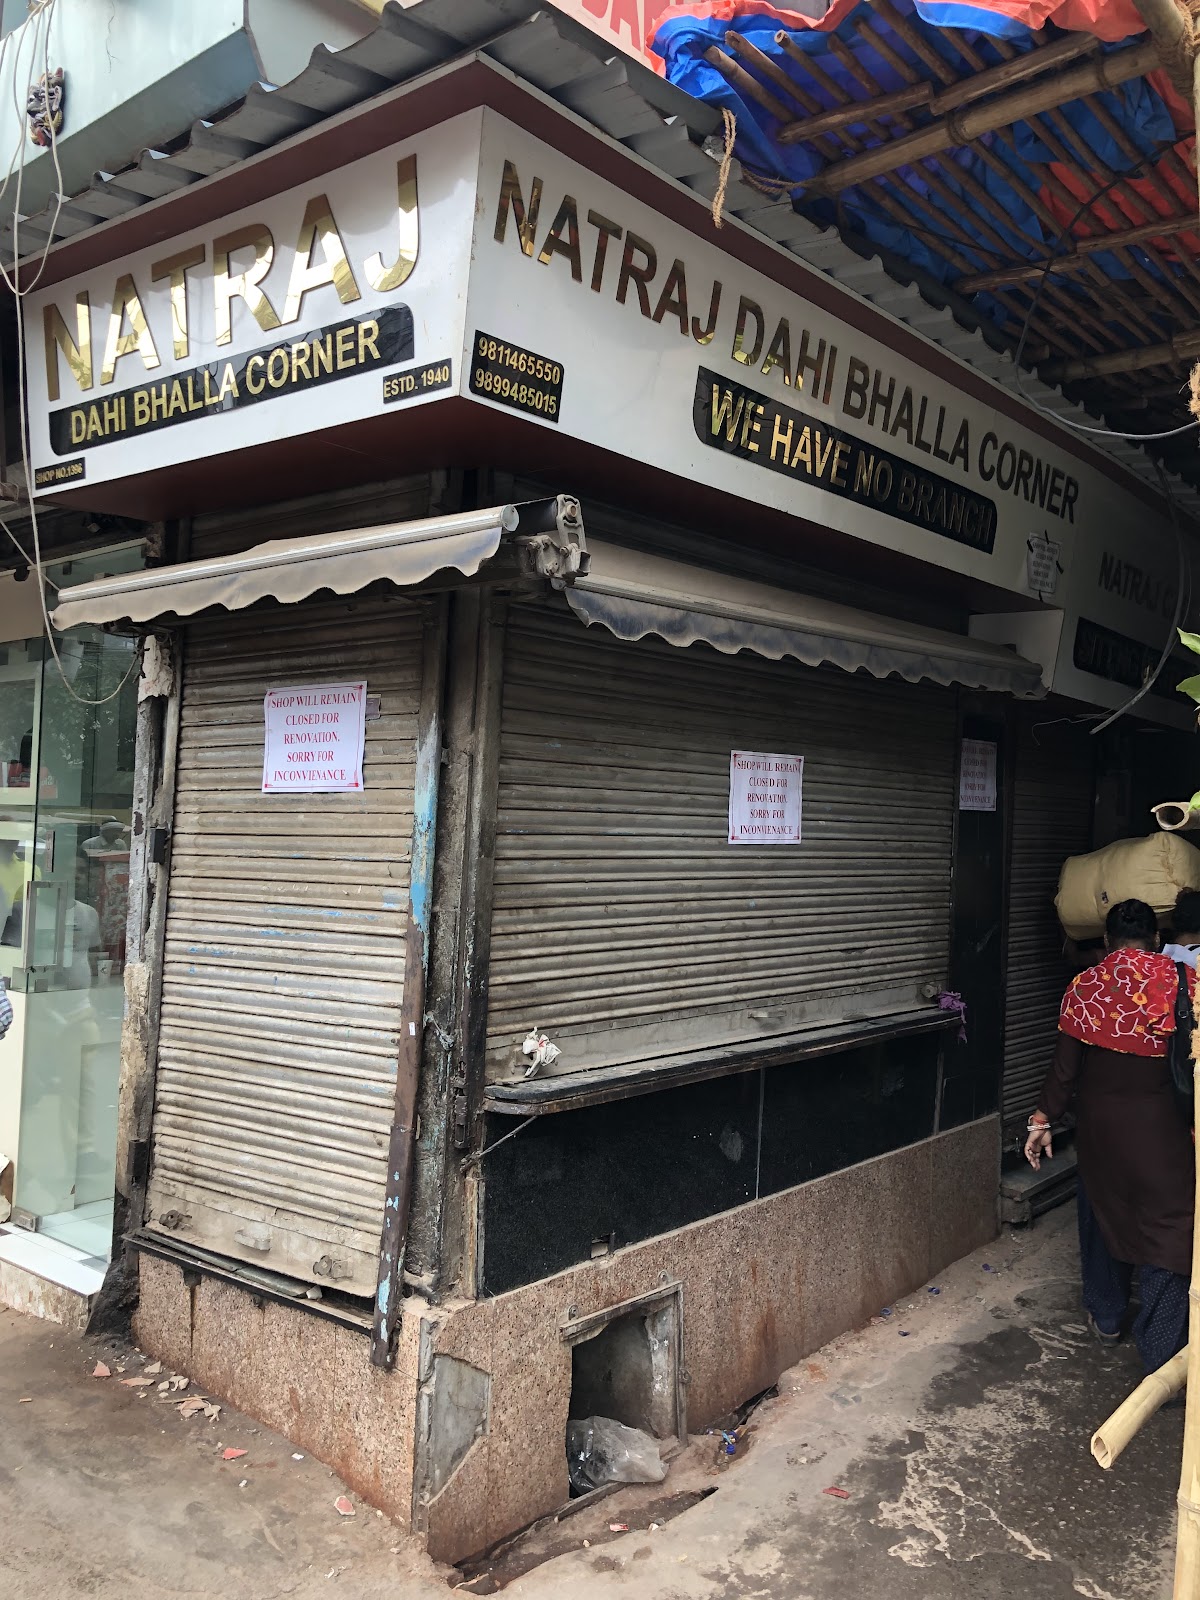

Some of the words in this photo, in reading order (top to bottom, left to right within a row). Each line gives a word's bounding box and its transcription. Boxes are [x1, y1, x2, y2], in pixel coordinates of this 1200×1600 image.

[43, 153, 421, 402] NATRAJ
[494, 159, 722, 346] NATRAJ
[731, 295, 838, 405] DAHI
[842, 355, 970, 473] BHALLA
[978, 432, 1079, 524] CORNER
[478, 336, 561, 385] 9811465550
[71, 397, 126, 444] DAHI
[134, 362, 239, 427] BHALLA
[246, 319, 381, 395] CORNER
[383, 375, 418, 398] ESTD.
[421, 365, 450, 387] 1940
[475, 368, 557, 415] 9899485015
[711, 383, 764, 453] WE
[770, 413, 851, 488] HAVE
[854, 450, 893, 502] NO
[899, 470, 993, 546] BRANCH
[35, 469, 55, 484] SHOP
[271, 697, 295, 709] SHOP
[296, 695, 319, 707] WILL
[320, 692, 357, 705] REMAIN
[286, 713, 320, 726] CLOSED
[321, 712, 339, 724] FOR
[284, 731, 340, 745] RENOVATION.
[287, 751, 315, 763] SORRY
[317, 750, 334, 762] FOR
[736, 760, 755, 770] SHOP
[755, 761, 773, 772] WILL
[775, 762, 800, 773] REMAIN
[273, 769, 347, 782] INCONVIENANCE
[749, 777, 775, 788] CLOSED
[776, 778, 788, 788] FOR
[750, 808, 770, 819] SORRY
[772, 809, 785, 819] FOR
